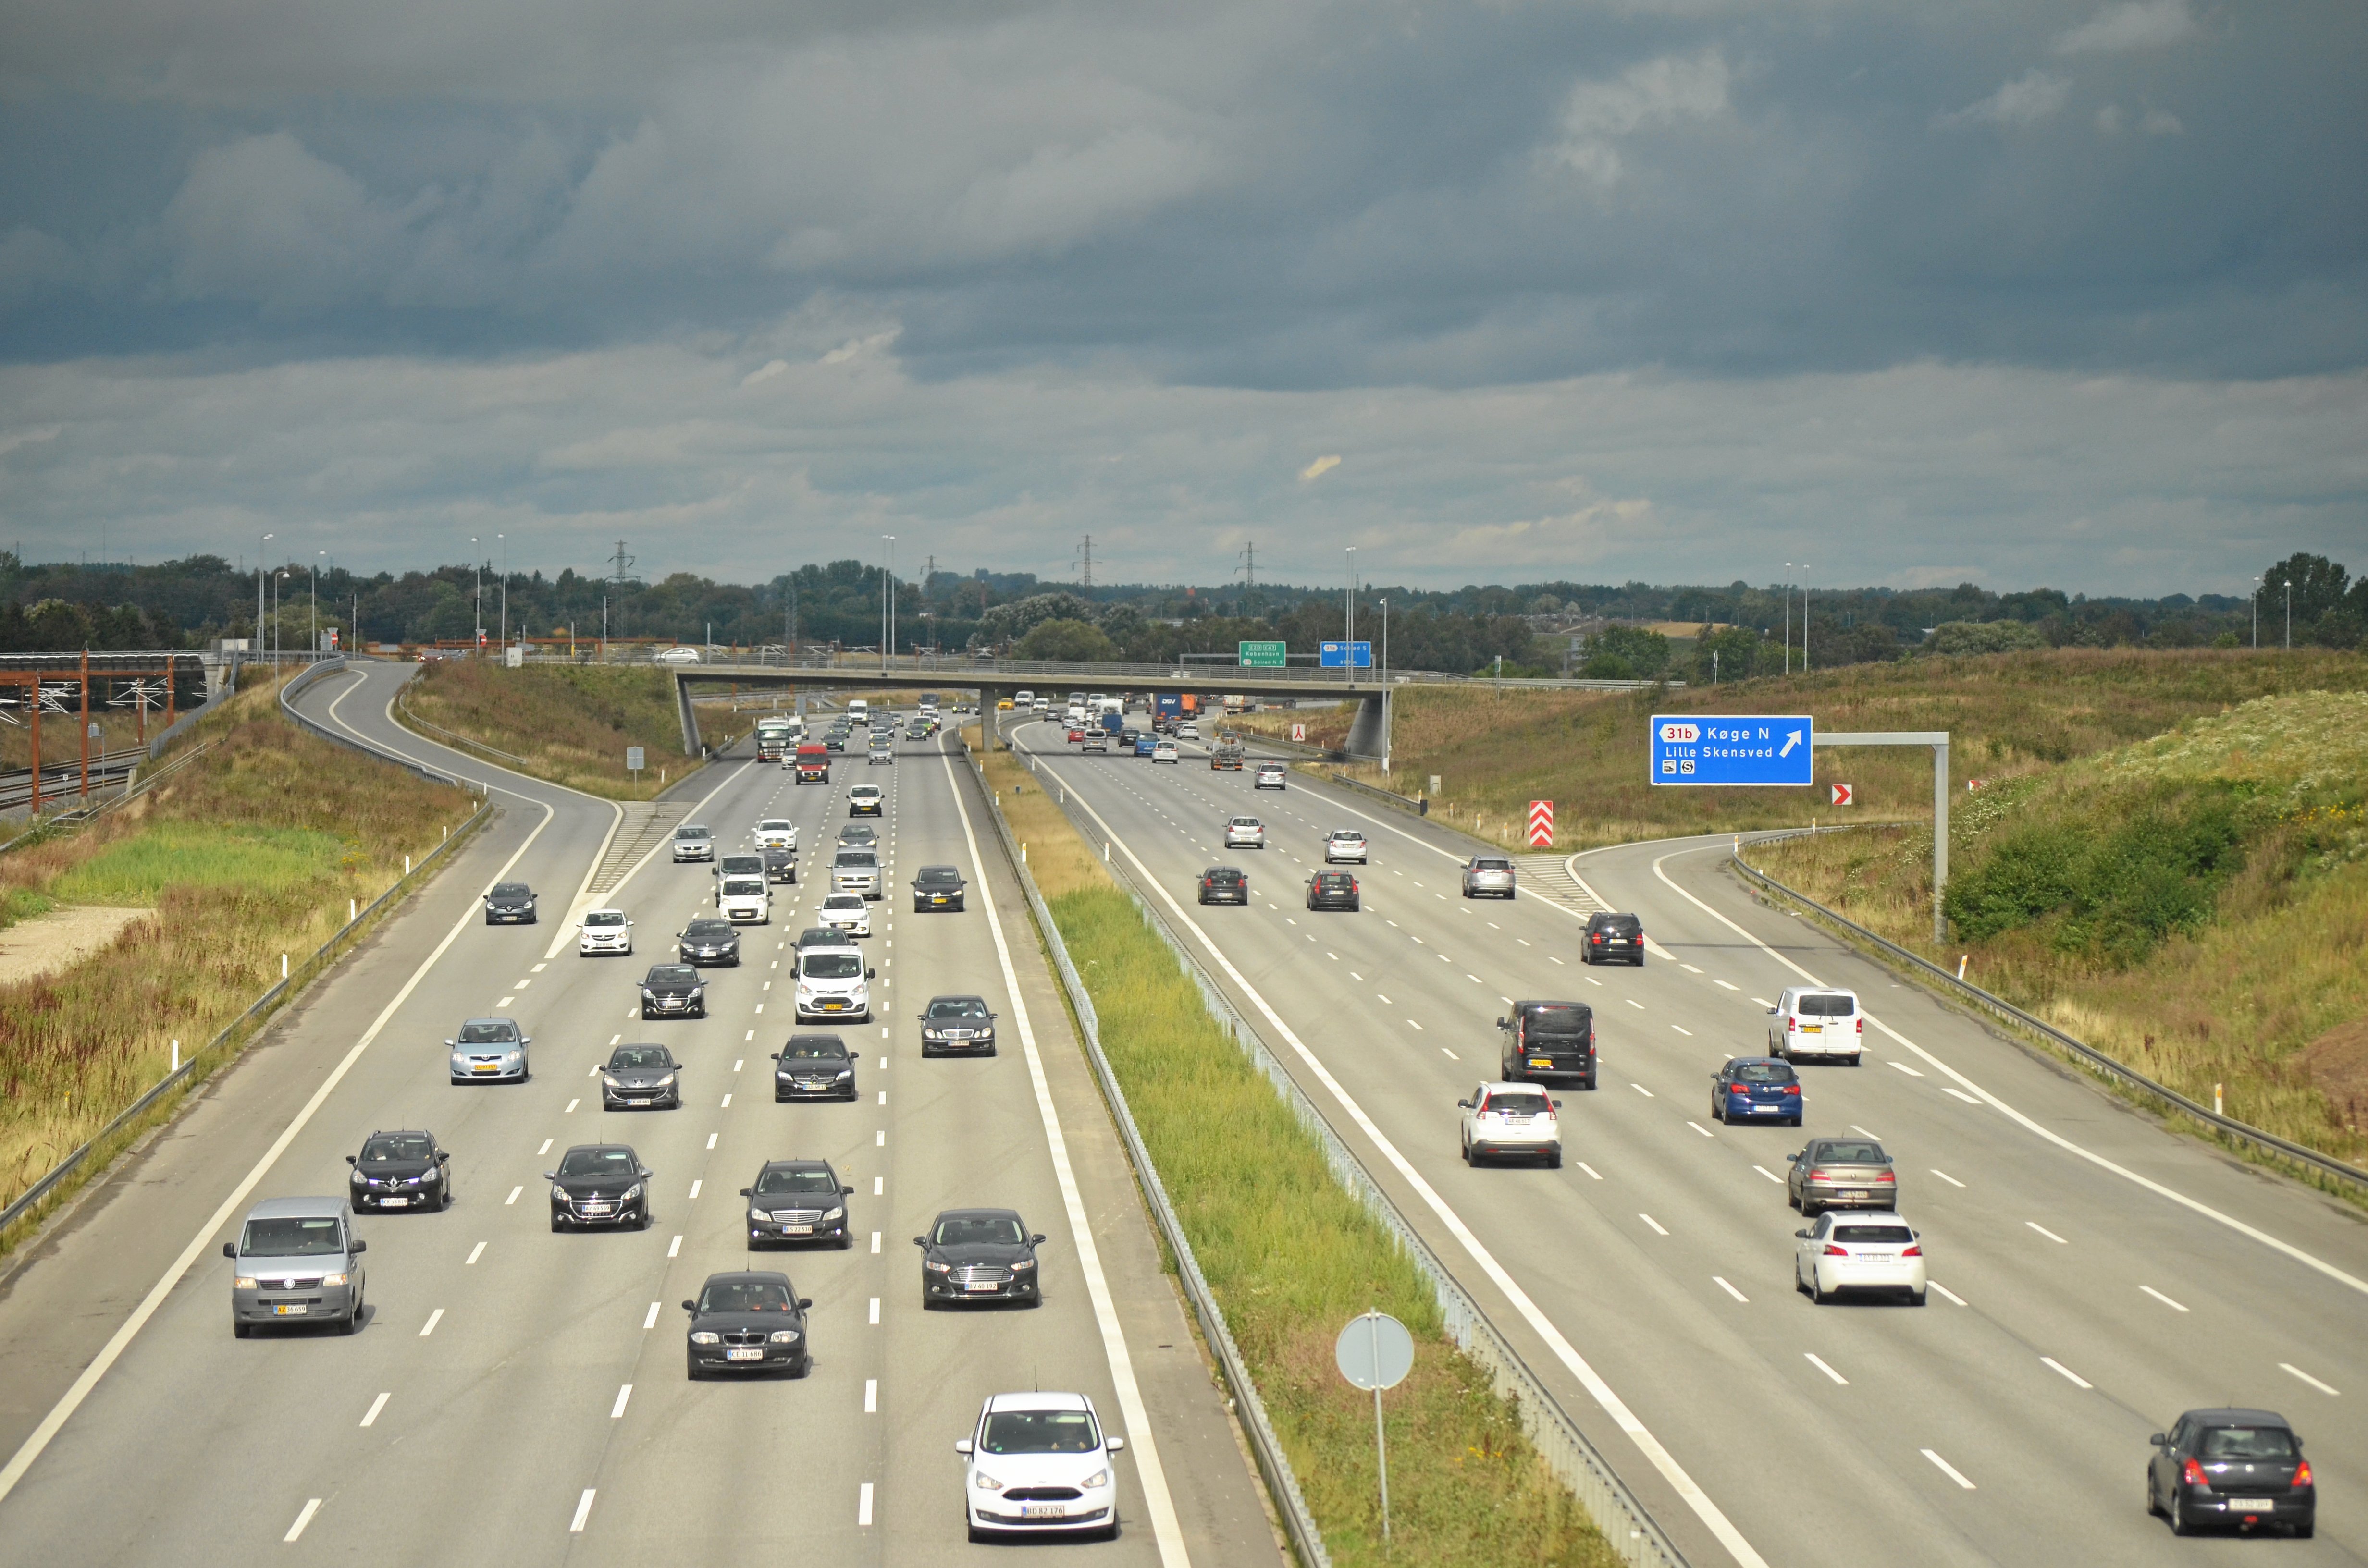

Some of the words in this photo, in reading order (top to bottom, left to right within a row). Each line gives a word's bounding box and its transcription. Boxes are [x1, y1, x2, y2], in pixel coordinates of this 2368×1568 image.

[1667, 727, 1693, 739] 31b
[1707, 727, 1750, 742] Køge
[1758, 727, 1769, 739] N
[1665, 747, 1696, 757] Lille
[1703, 747, 1773, 757] Skensved
